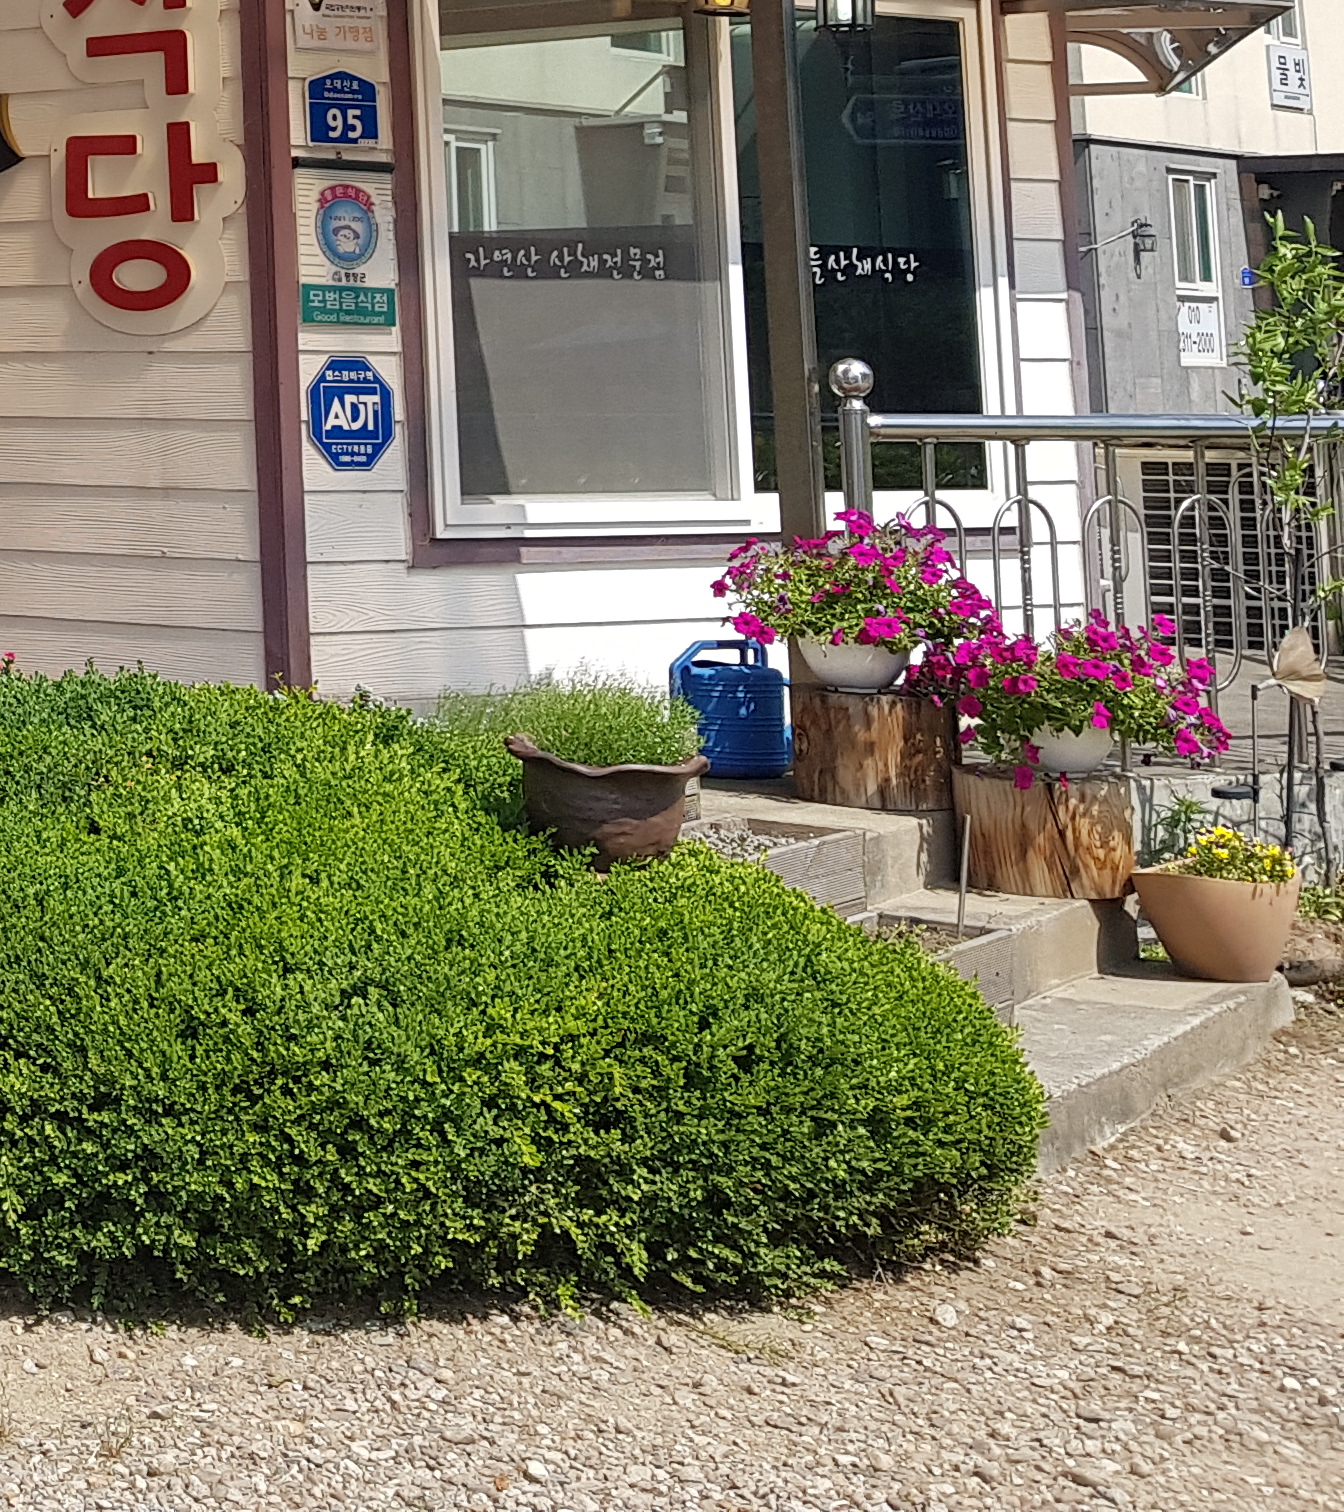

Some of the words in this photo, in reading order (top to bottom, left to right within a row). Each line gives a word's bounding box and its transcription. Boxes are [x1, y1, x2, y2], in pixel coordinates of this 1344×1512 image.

[302, 23, 328, 41] 나눔
[326, 107, 363, 139] 95
[464, 245, 543, 278] 자연산
[549, 242, 666, 280] 산채전문점
[308, 290, 388, 312] 모범음식점
[313, 311, 338, 323] Good
[339, 312, 386, 325] Restaurant
[324, 394, 380, 431] ADT
